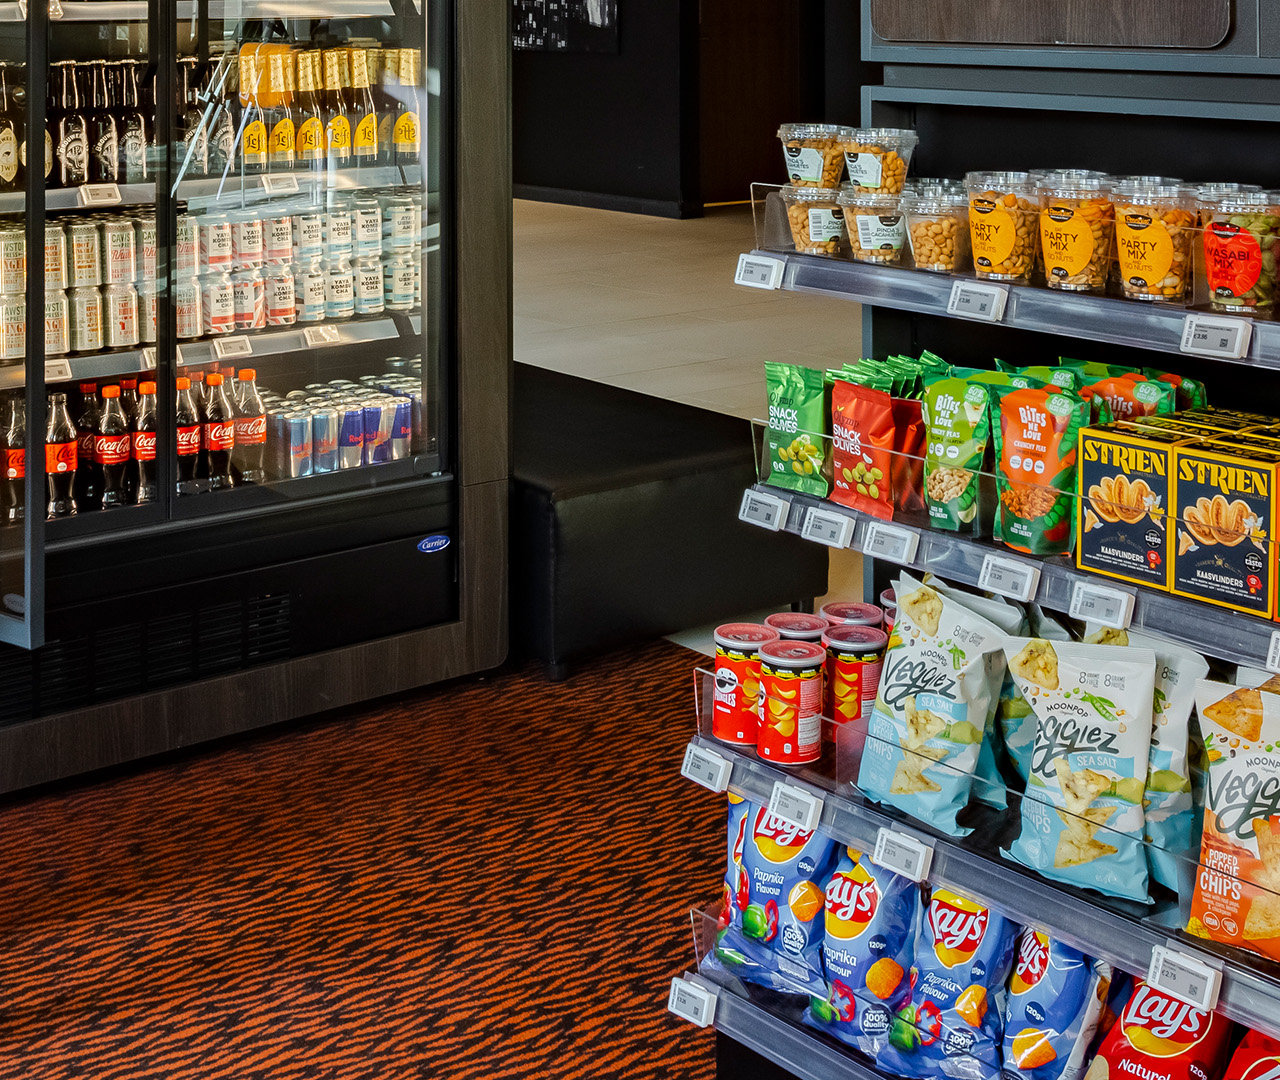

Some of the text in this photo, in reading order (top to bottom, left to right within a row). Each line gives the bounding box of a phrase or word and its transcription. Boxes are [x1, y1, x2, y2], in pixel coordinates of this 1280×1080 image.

[975, 232, 992, 242] MIX
[1044, 229, 1078, 243] PARTY
[1050, 240, 1069, 251] MIX
[1121, 238, 1158, 251] PARTY
[1127, 249, 1147, 260] MIX
[1213, 258, 1235, 270] MIX
[769, 405, 798, 421] SNACK
[769, 417, 797, 433] OLIVES
[934, 416, 953, 428] LOVE
[833, 424, 861, 444] SNACK
[1023, 429, 1041, 441] LOVE
[833, 435, 861, 456] OLIVES
[1084, 439, 1166, 476] STRIEN
[1179, 458, 1269, 497] STRIEN
[421, 537, 447, 550] Carrier
[1101, 545, 1145, 563] KAASVLINDERS
[1196, 569, 1244, 588] KAASVLINDERS
[920, 649, 948, 667] MOONPOP
[921, 698, 954, 714] SEA SALT
[1046, 703, 1089, 718] MOONPOP
[1077, 755, 1117, 769] SEA SALT
[1209, 848, 1238, 866] POPPED
[753, 867, 785, 886] Paprika
[1205, 859, 1240, 879] VEGGIE
[755, 881, 781, 896] Flavour
[1199, 871, 1243, 901] CHIPS
[930, 900, 988, 946] Lay's
[823, 945, 857, 967] Paprika
[825, 960, 852, 979] Flavour
[924, 971, 958, 992] Paprika
[919, 983, 950, 1002] Flavour
[863, 1020, 890, 1030] Quality
[865, 1012, 888, 1023] 100%
